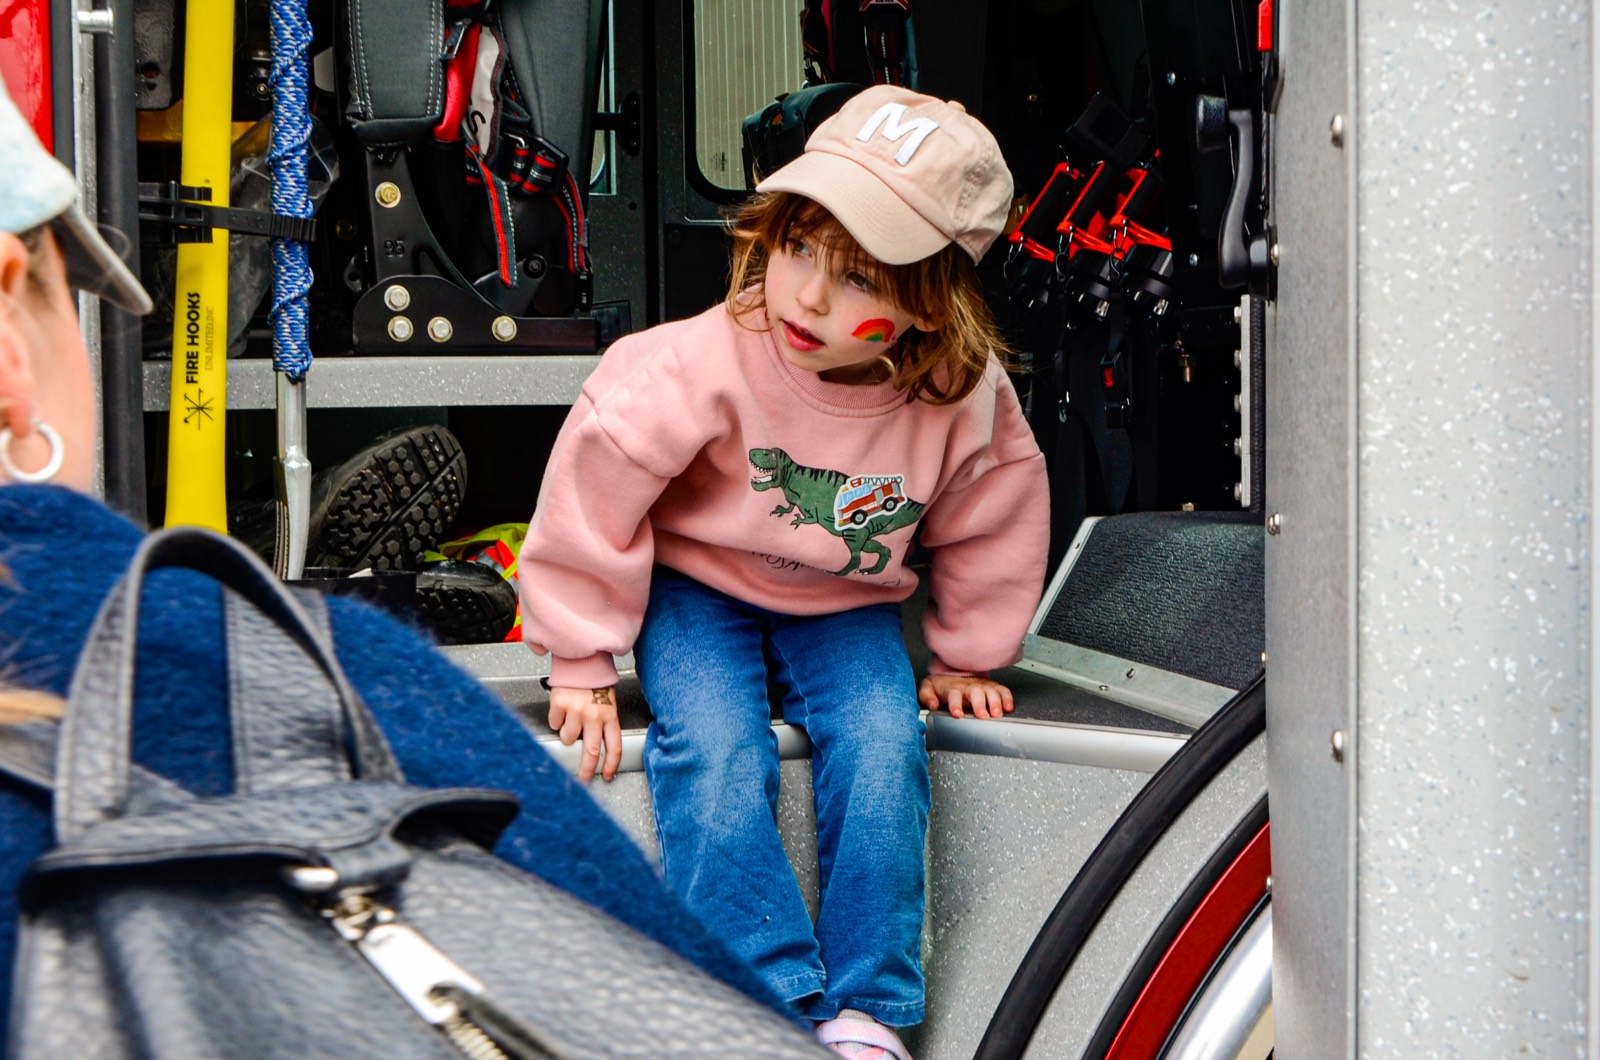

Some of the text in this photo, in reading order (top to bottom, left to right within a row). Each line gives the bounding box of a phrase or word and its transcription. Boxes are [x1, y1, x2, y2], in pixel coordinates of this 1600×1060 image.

[856, 102, 940, 167] M
[384, 240, 405, 257] 95
[186, 292, 200, 384] FIRE HOOKS
